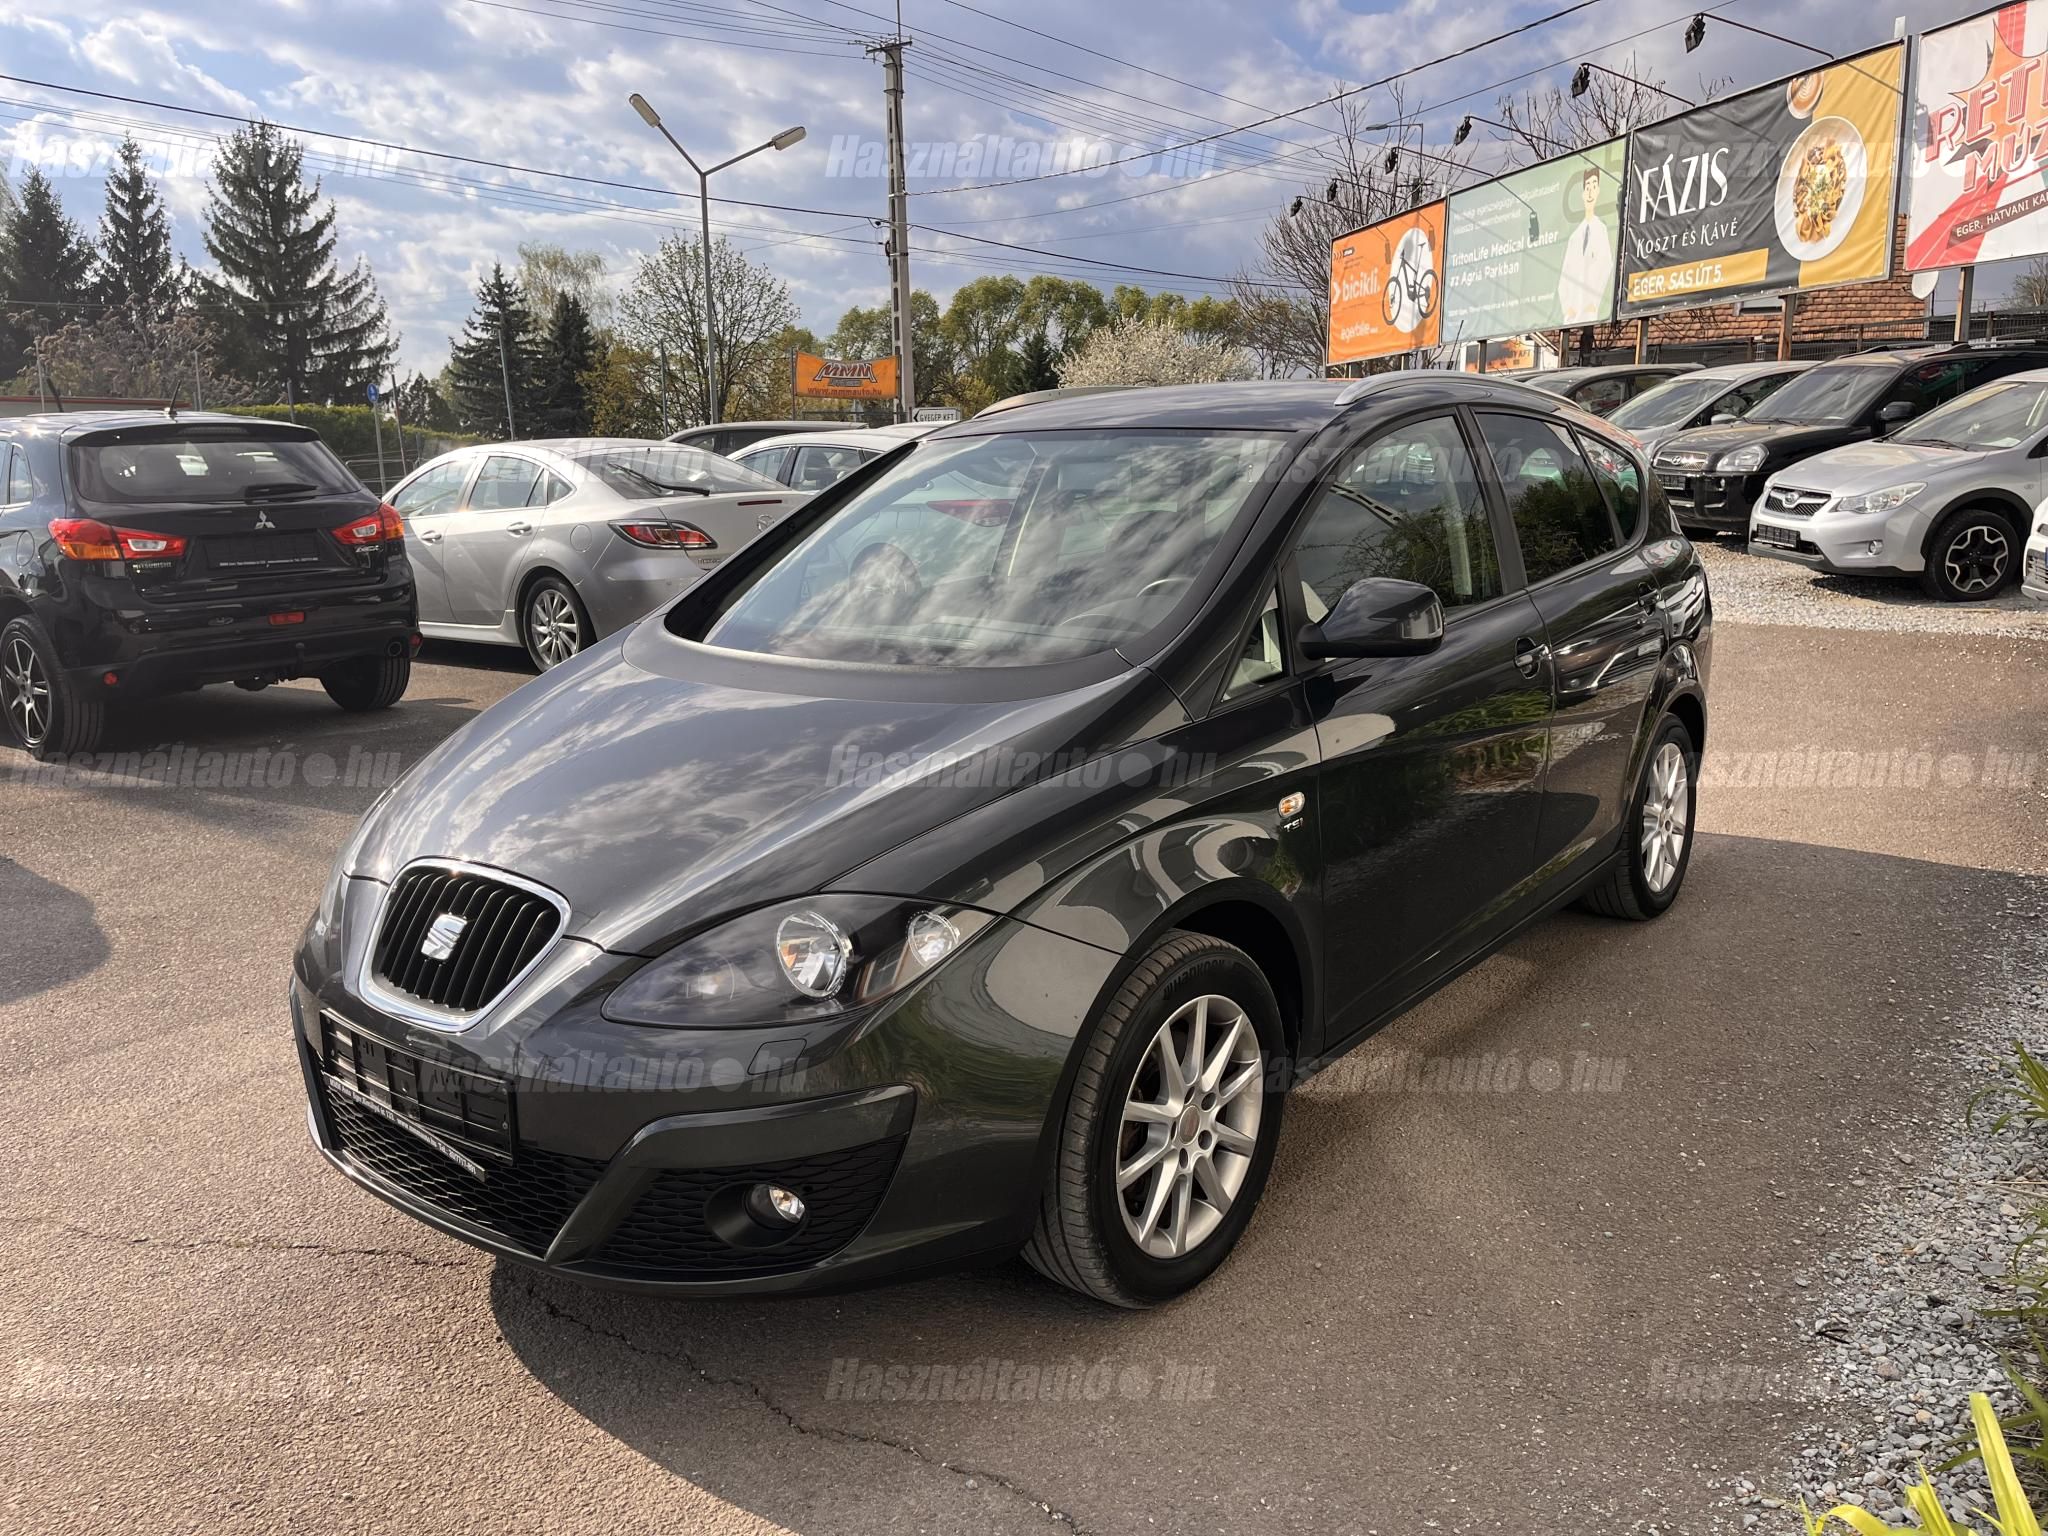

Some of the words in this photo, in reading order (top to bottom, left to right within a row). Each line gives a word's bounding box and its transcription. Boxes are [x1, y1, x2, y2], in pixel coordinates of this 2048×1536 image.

[1924, 54, 2048, 163] RET
[1633, 148, 1728, 223] FÁZIS
[1956, 219, 1983, 238] EGER,
[1987, 199, 2029, 225] HATVANI
[1452, 246, 1488, 267] TritonLife
[1490, 236, 1524, 257] Medical
[1527, 231, 1559, 248] Center
[1637, 234, 1677, 259] KOSZT
[1701, 217, 1738, 246] KÁVÉ
[1460, 269, 1482, 286] Agria
[1485, 261, 1520, 279] Parkban
[1633, 275, 1666, 297] EGER,
[1669, 270, 1694, 291] SAS
[1696, 263, 1714, 285] ÚT
[1284, 817, 1304, 832] TSI
